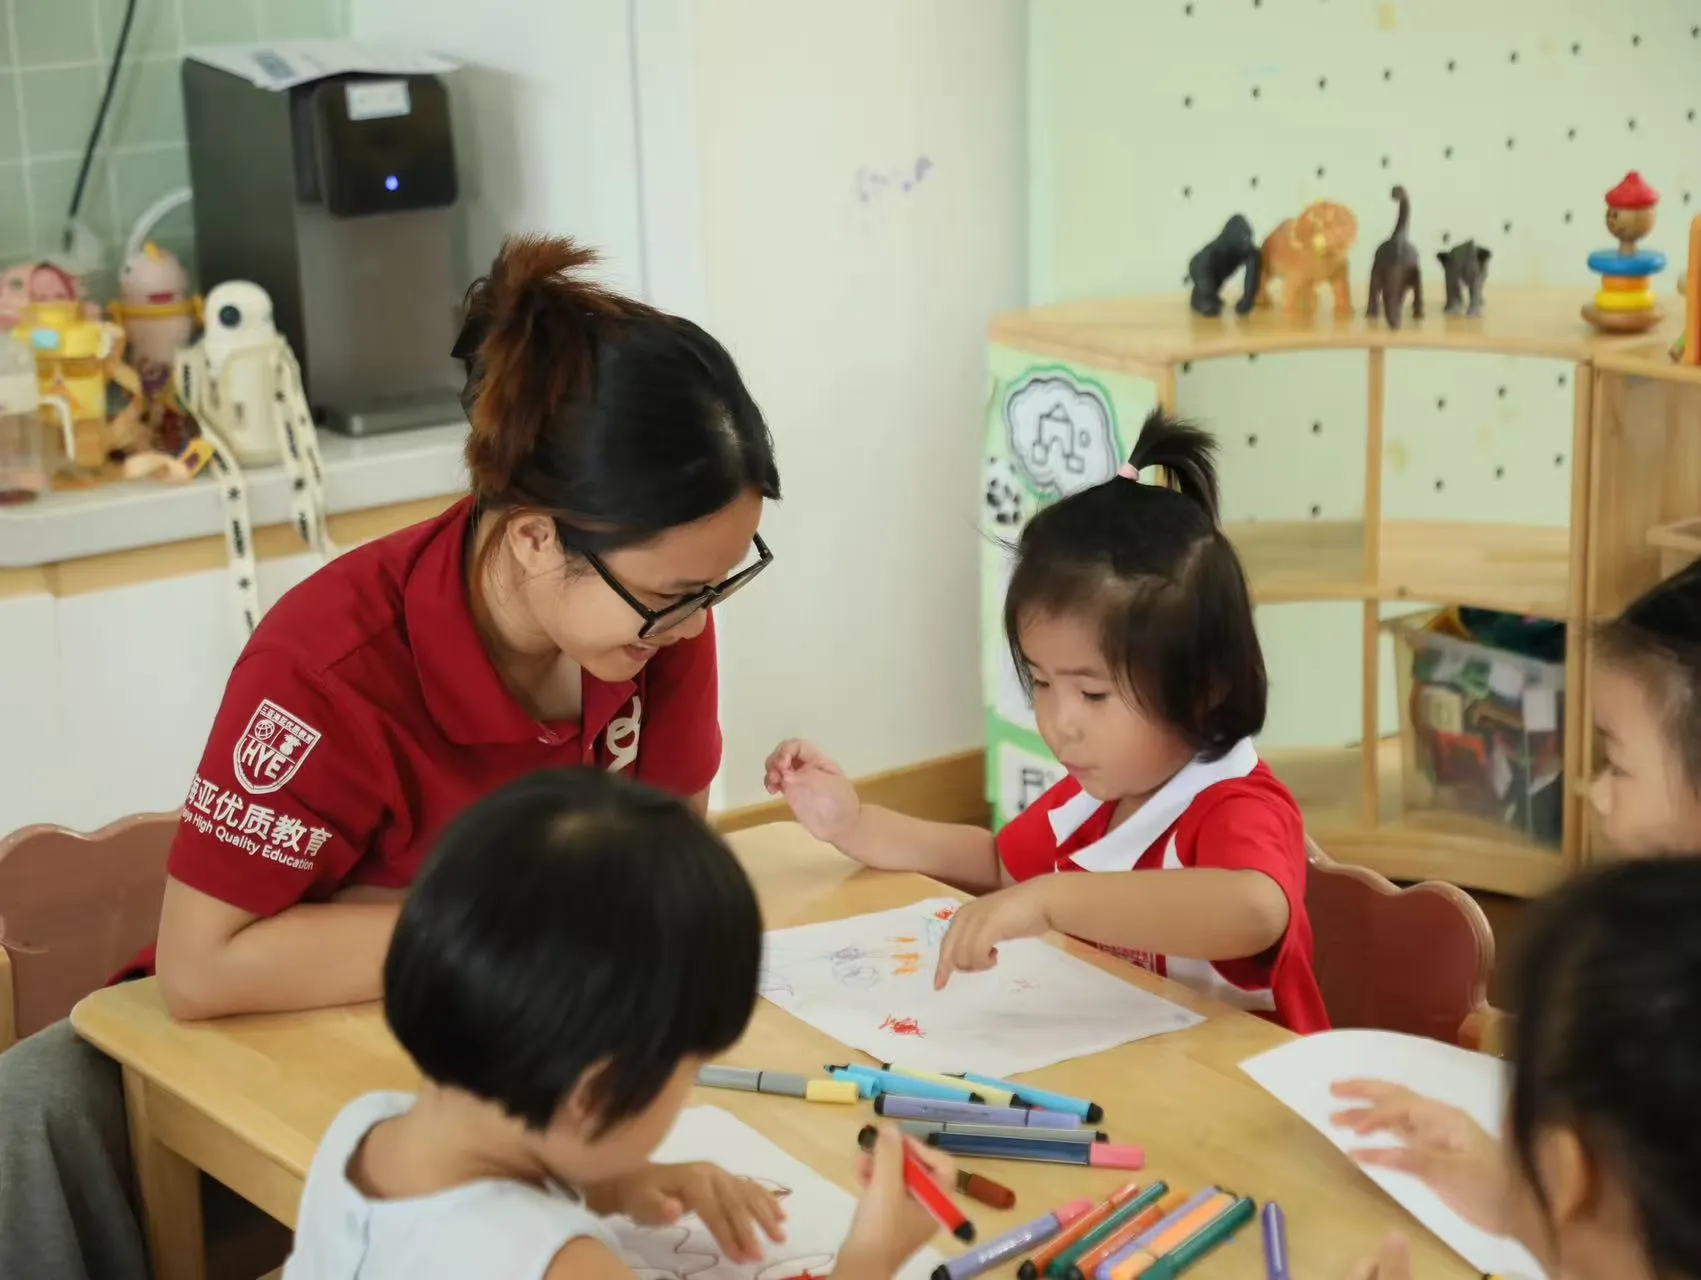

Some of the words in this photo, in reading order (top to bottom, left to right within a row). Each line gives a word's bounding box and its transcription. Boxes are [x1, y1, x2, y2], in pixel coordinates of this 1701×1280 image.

[241, 739, 286, 780] HYE
[192, 813, 213, 834] High
[215, 825, 261, 855] Quality
[262, 844, 313, 870] Education
